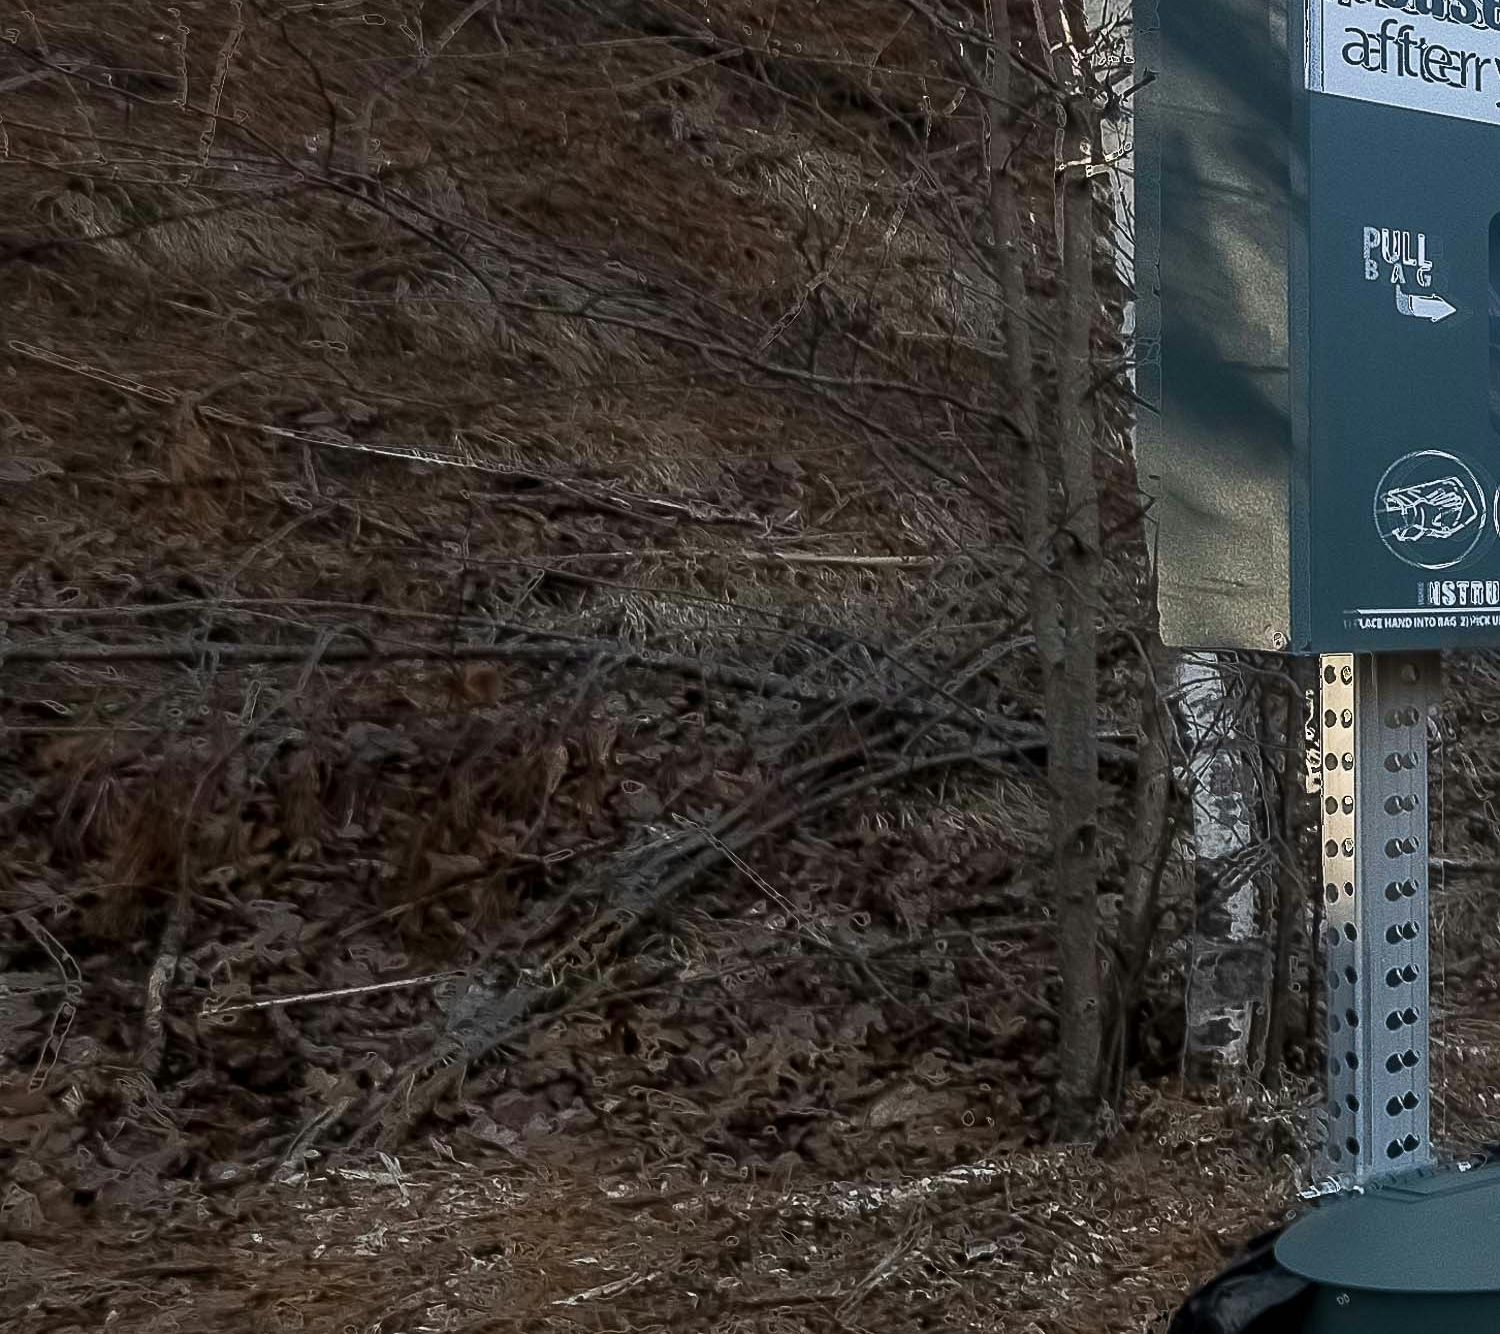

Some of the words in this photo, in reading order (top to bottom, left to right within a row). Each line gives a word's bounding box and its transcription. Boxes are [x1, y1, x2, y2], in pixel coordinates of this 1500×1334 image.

[1341, 18, 1492, 93] after
[1363, 226, 1433, 268] PULL
[1384, 617, 1412, 628] HAND
[1413, 616, 1437, 628] INTO
